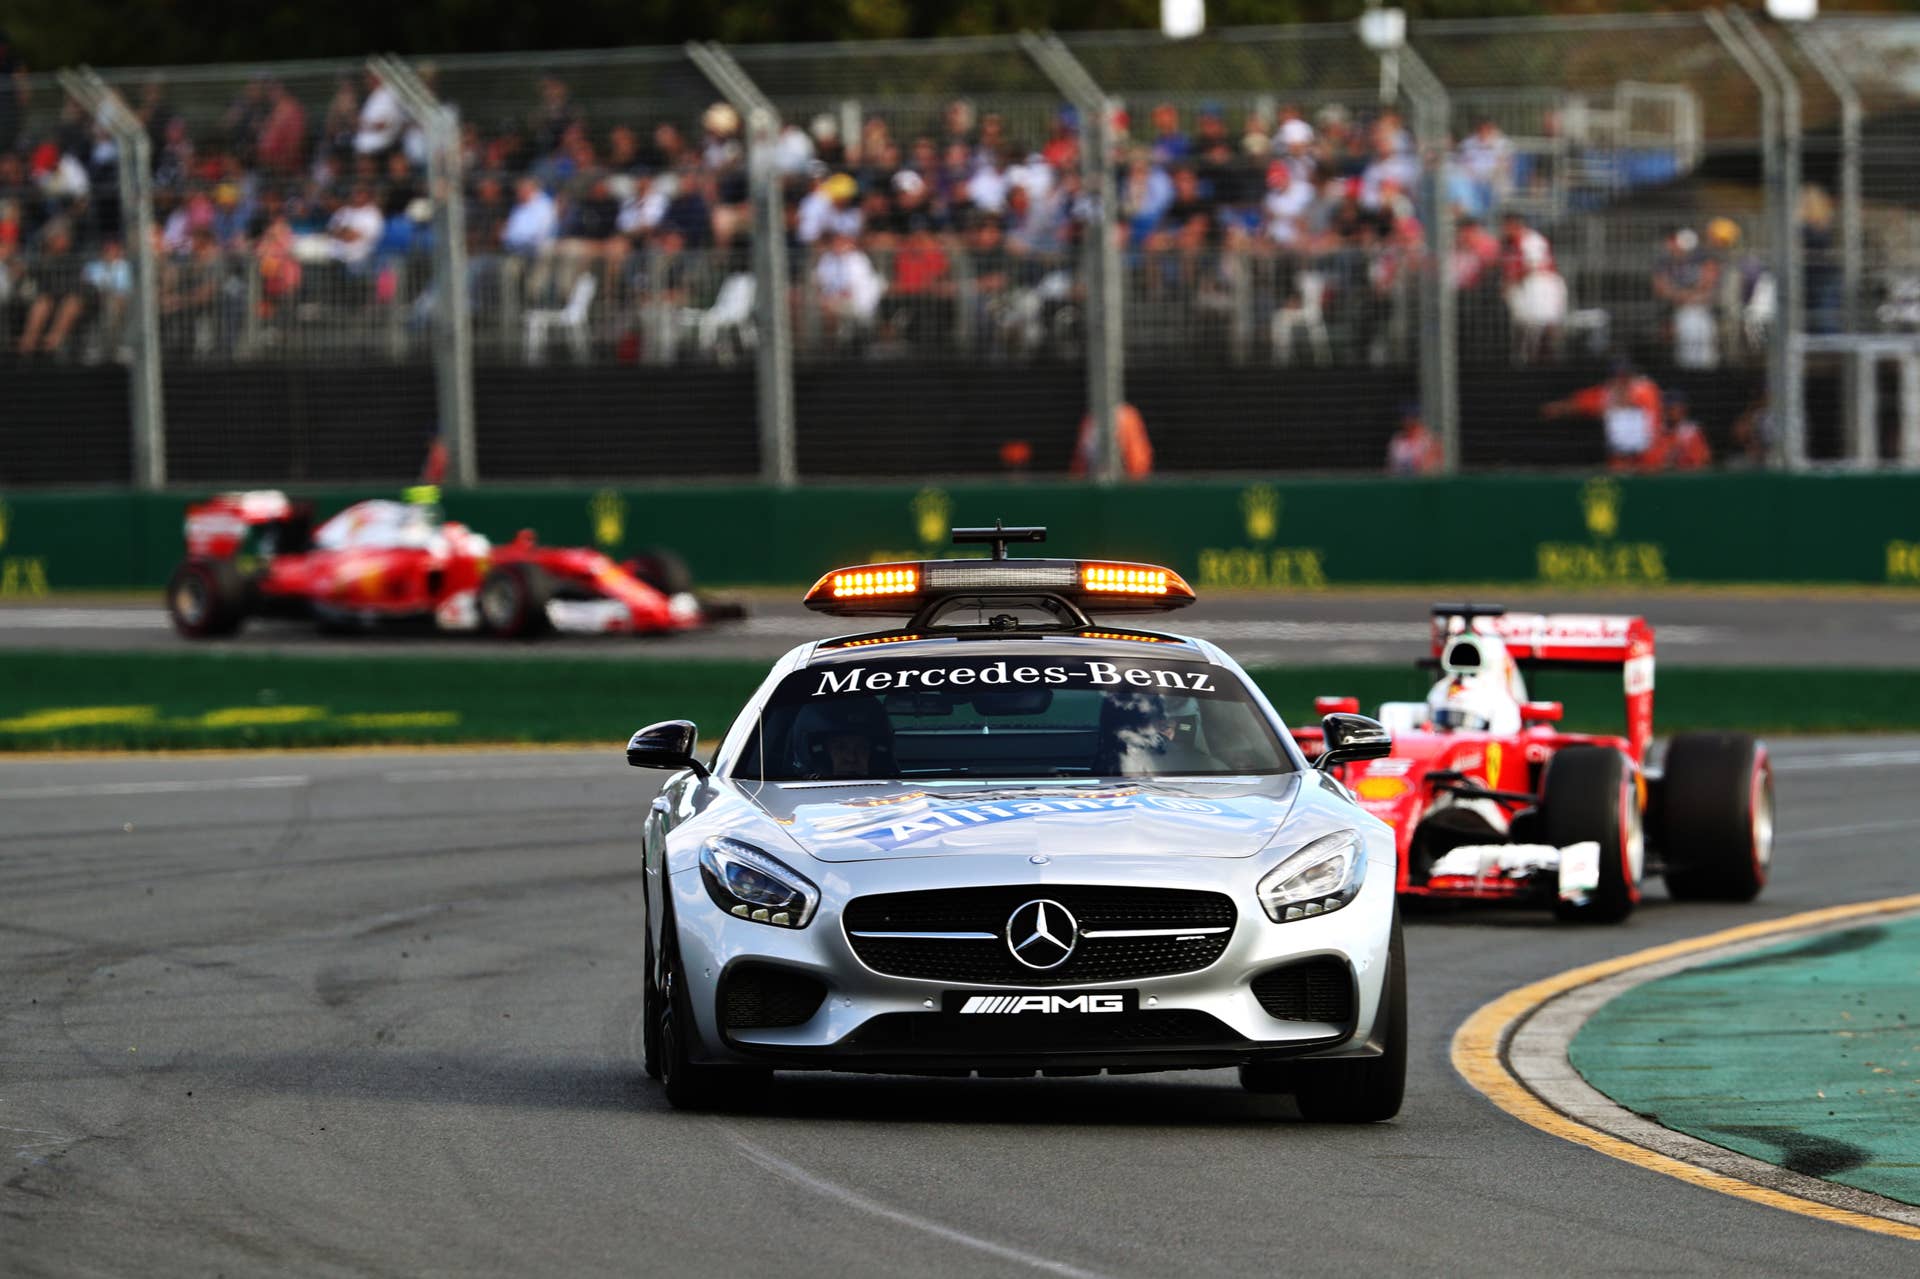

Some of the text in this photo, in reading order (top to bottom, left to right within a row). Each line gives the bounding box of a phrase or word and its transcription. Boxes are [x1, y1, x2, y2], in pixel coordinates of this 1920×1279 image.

[811, 661, 1216, 697] Mercedes-Benz
[887, 796, 1139, 842] Allianz
[1010, 995, 1124, 1014] AMG
